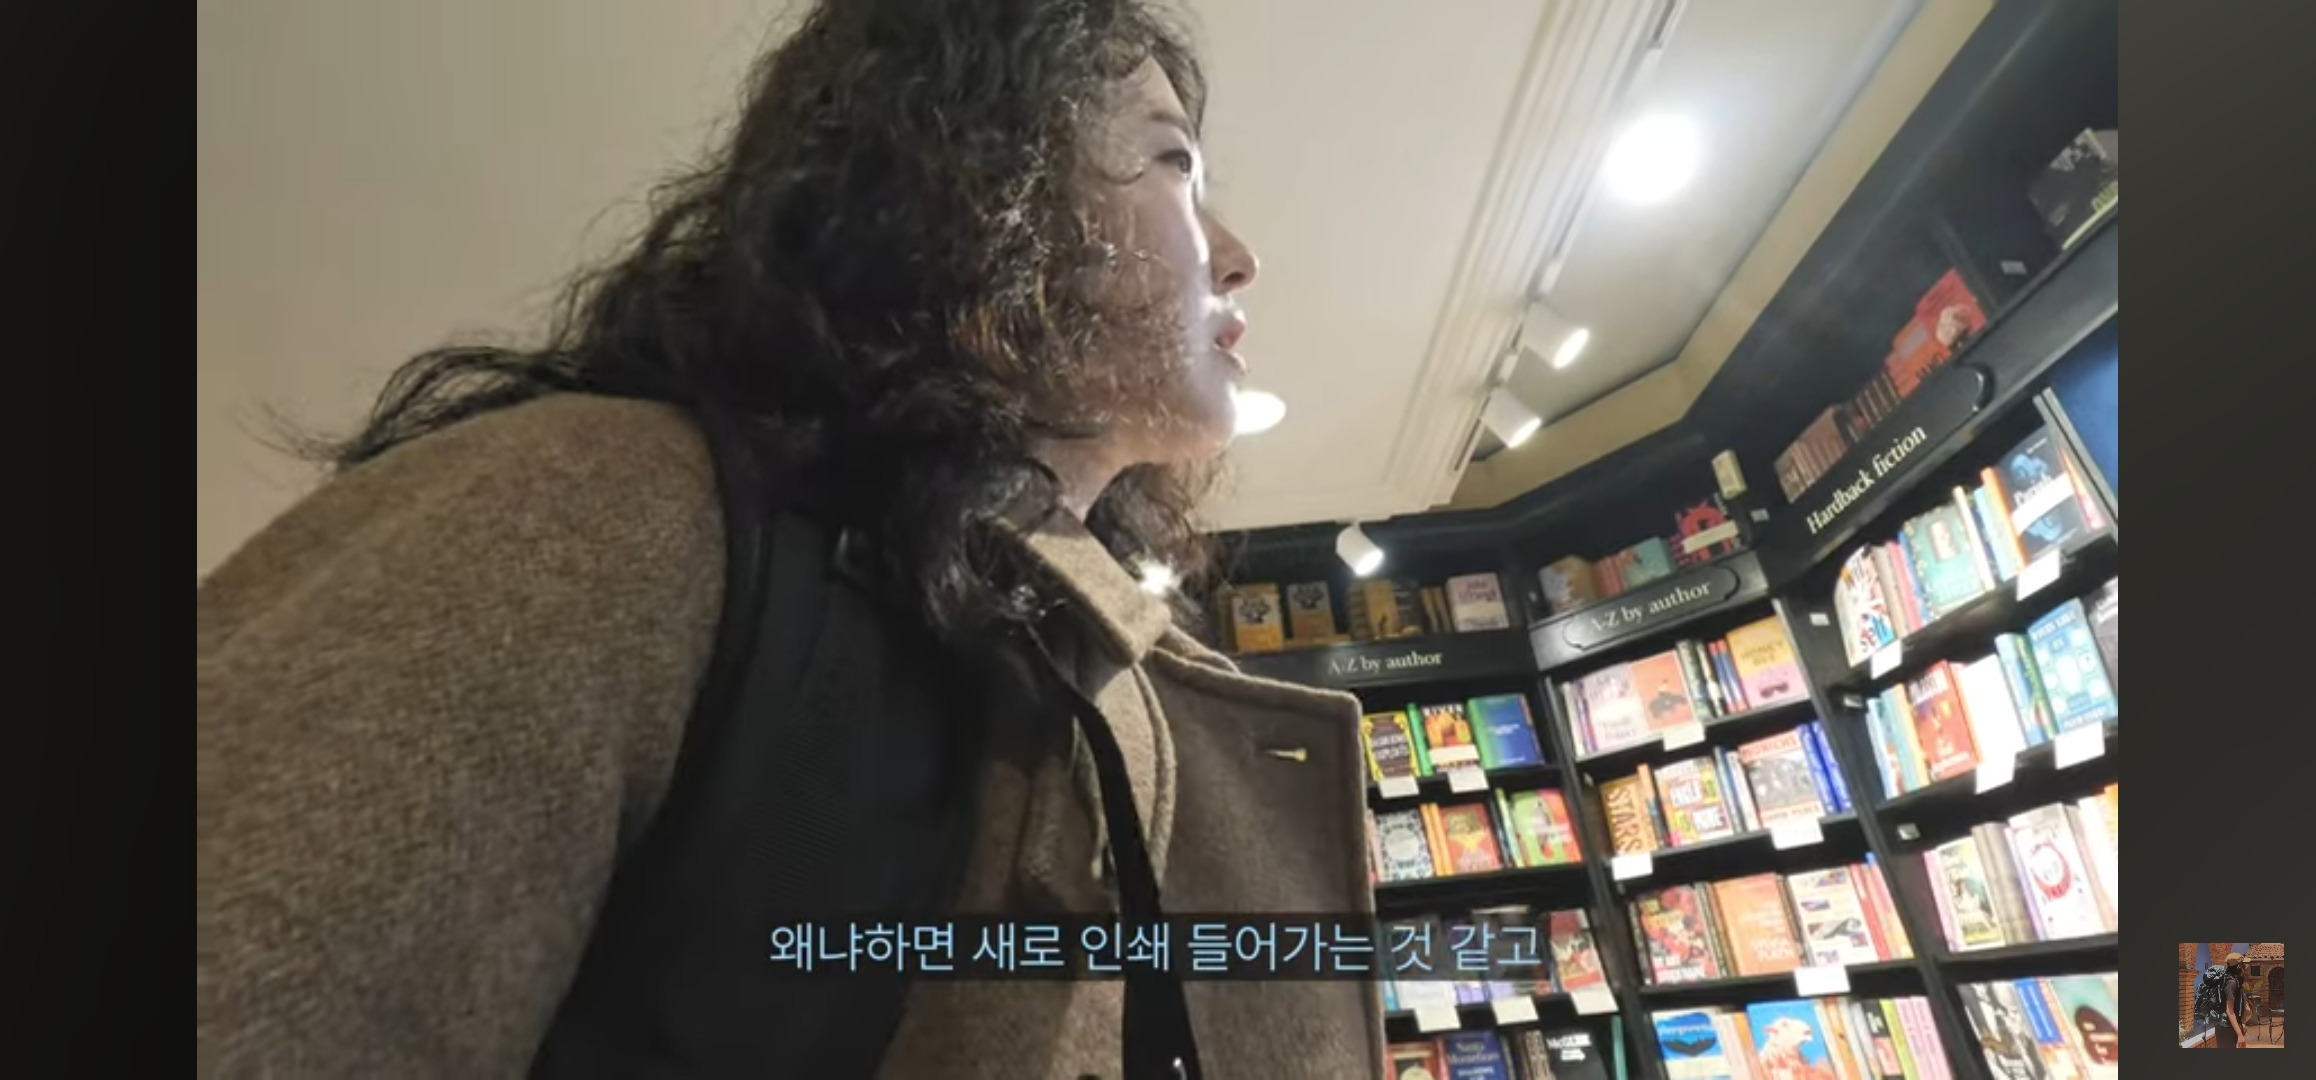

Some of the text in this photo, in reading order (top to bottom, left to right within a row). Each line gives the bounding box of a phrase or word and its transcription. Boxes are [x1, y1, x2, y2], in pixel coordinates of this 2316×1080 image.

[1806, 426, 1927, 534] Hardback fiction
[1620, 606, 1642, 624] by
[1649, 581, 1710, 614] author
[1360, 654, 1380, 675] by
[1385, 650, 1442, 669] author
[1607, 784, 1644, 853] STARS
